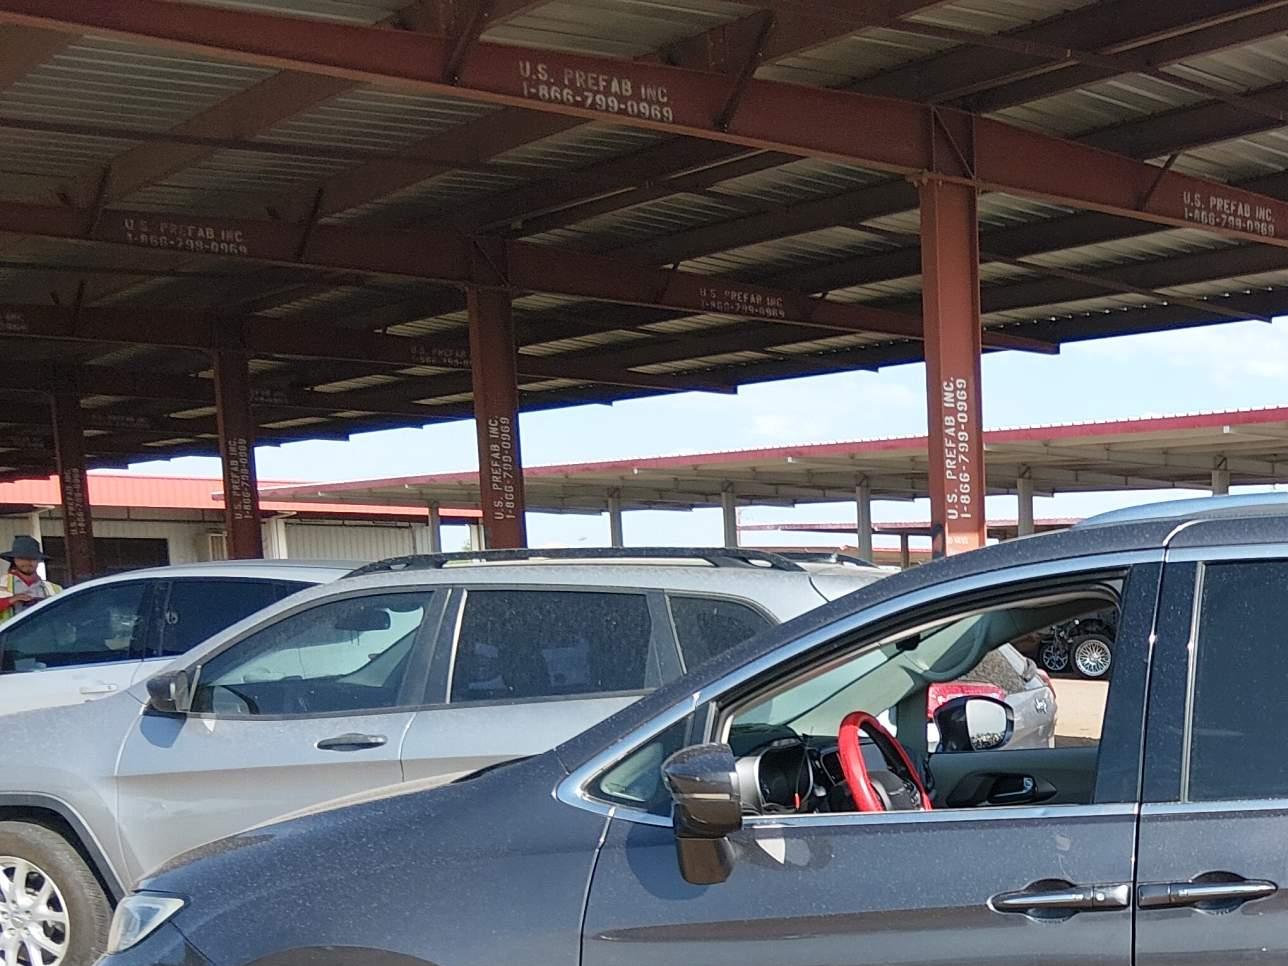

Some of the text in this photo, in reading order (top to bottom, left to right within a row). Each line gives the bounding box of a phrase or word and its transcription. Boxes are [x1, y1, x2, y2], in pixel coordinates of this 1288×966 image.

[518, 61, 554, 84] U.S.
[563, 69, 633, 97] PREFAB
[521, 81, 674, 123] 1-866-799-0969
[1183, 191, 1206, 209] U.S.
[1209, 196, 1251, 218] PREFAB
[943, 376, 956, 409] INC.
[490, 443, 504, 492] PREFAB
[944, 415, 959, 481] PREFAB
[956, 378, 973, 520] 1-866-799-0969
[500, 416, 516, 520] 1-866-799-0969
[494, 496, 505, 521] U.S.
[947, 488, 960, 520] U.S.
